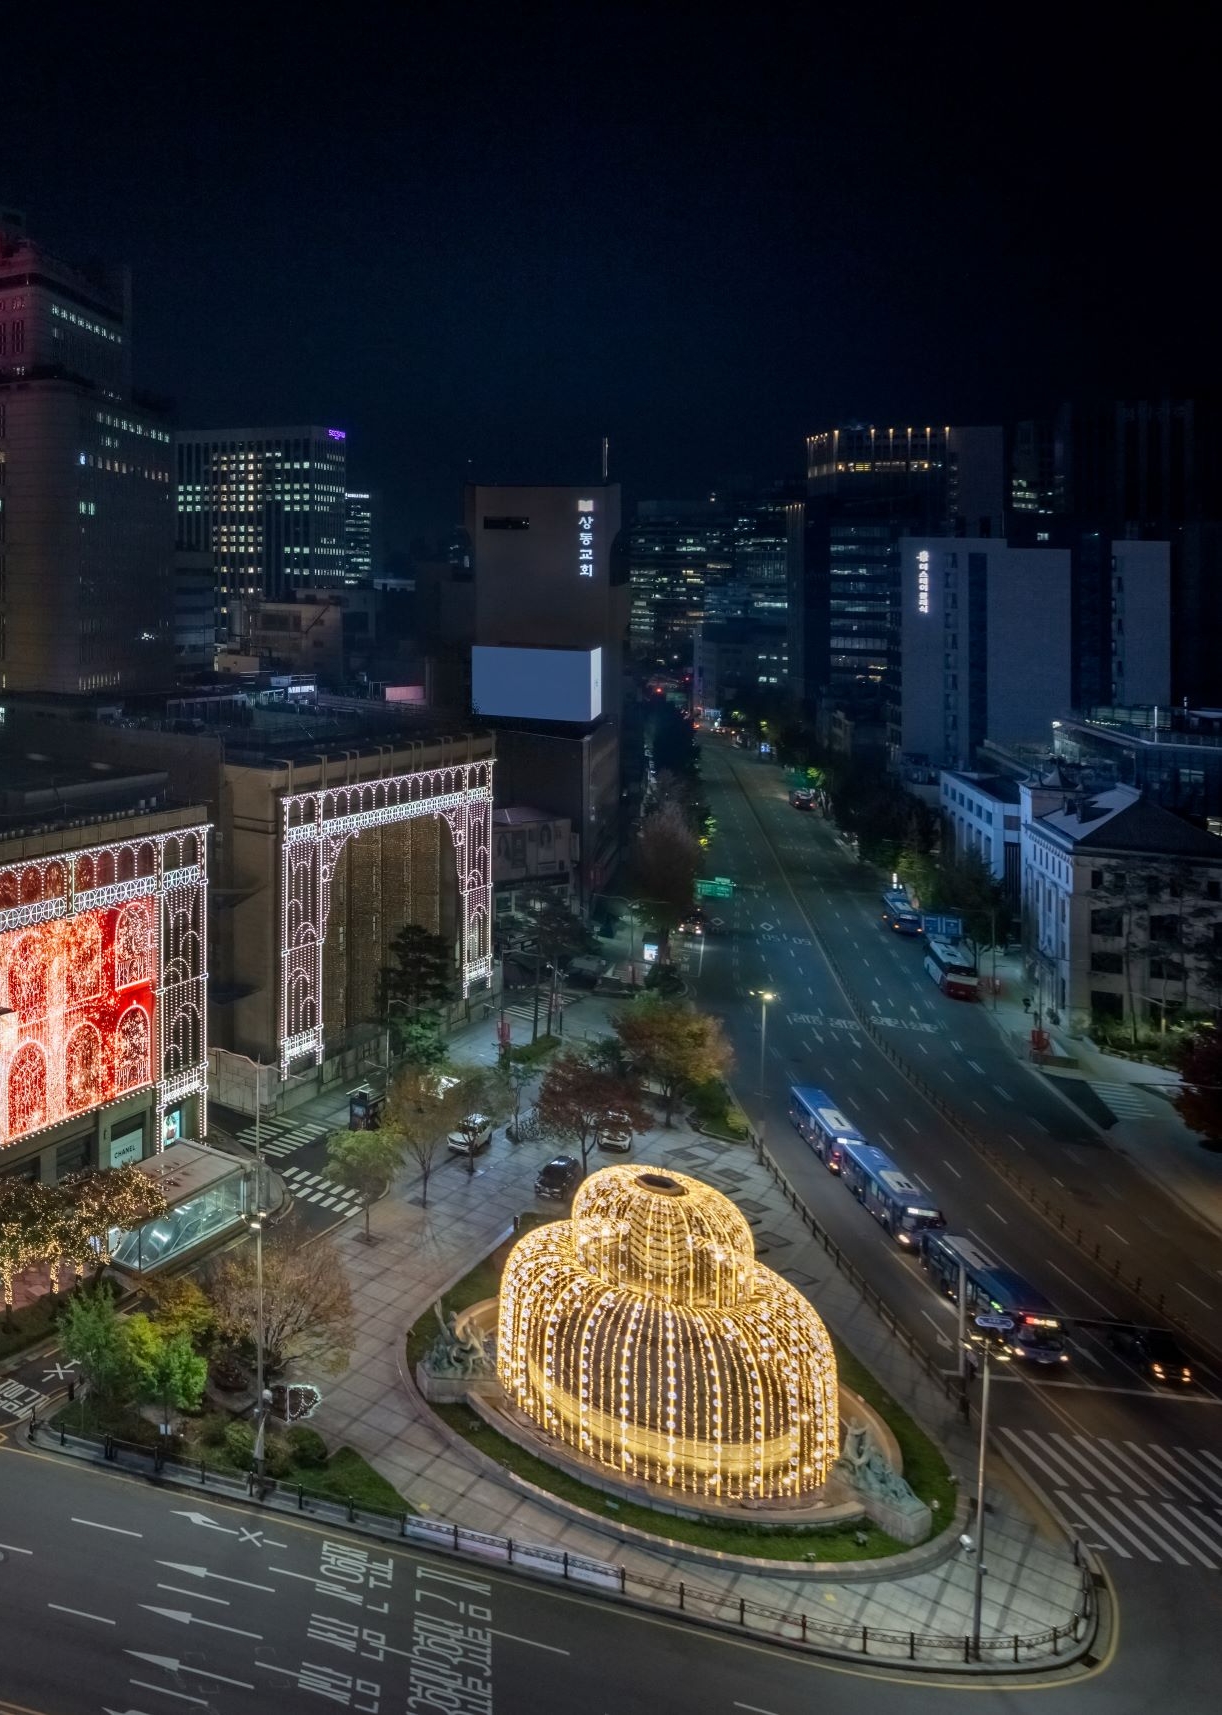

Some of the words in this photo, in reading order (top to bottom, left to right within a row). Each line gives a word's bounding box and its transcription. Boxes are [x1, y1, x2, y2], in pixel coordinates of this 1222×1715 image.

[578, 516, 594, 577] 상동교회
[114, 1145, 136, 1159] CHANEL
[320, 1540, 394, 1589] 우회전
[415, 1566, 492, 1622] 금지
